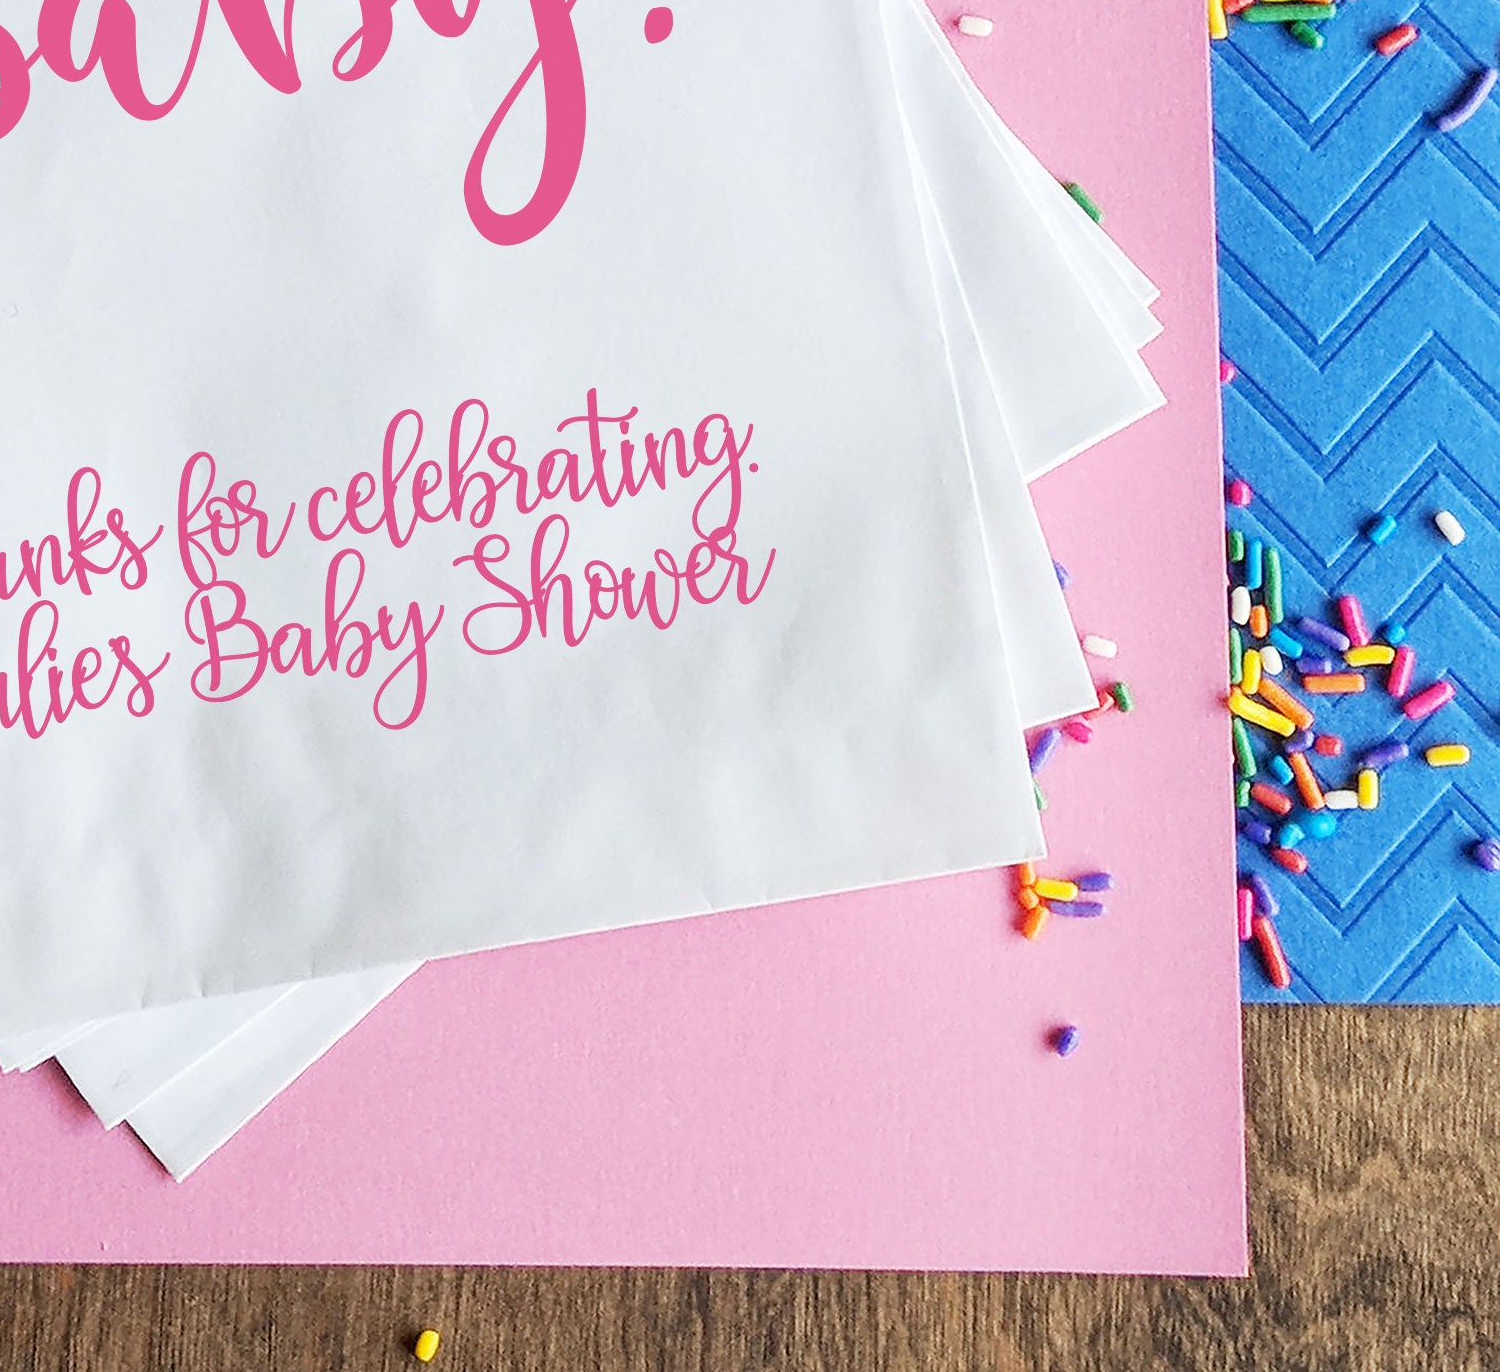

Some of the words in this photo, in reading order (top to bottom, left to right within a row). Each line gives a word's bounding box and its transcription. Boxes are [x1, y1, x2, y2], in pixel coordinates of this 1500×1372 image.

[178, 451, 296, 590] for
[308, 388, 760, 548] celebrating.
[185, 548, 445, 730] Baby
[452, 513, 776, 656] Shower
